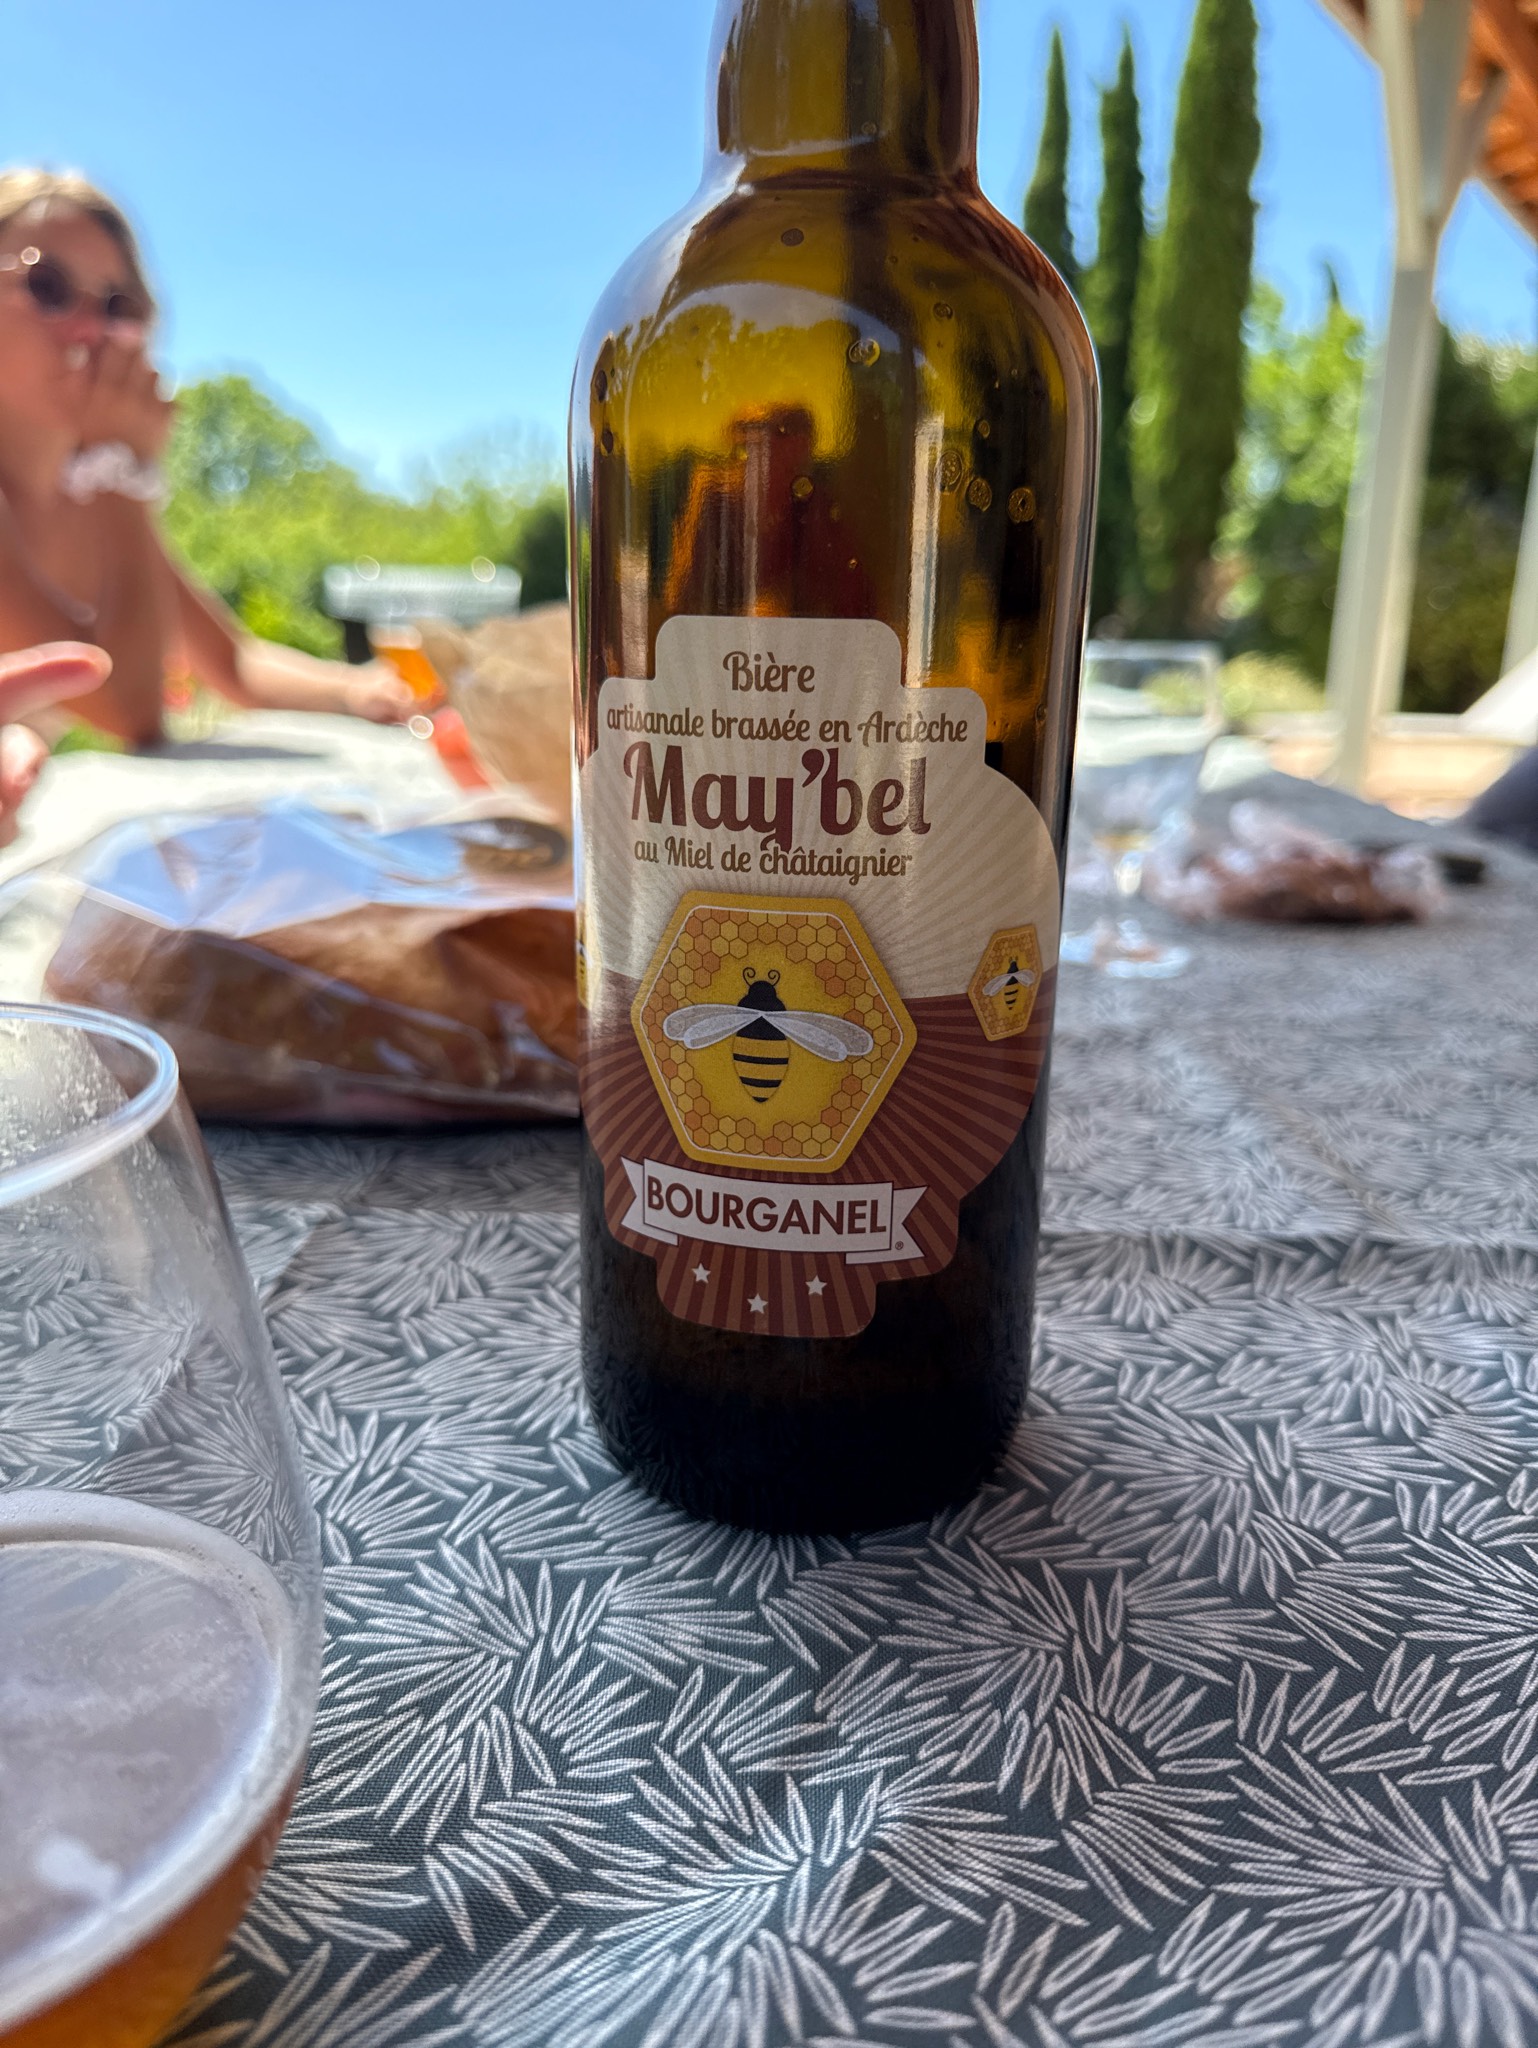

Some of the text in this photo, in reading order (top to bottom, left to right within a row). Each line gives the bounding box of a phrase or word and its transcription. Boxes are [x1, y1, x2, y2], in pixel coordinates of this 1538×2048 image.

[723, 650, 815, 693] Bière
[607, 706, 968, 747] artisanale brassée en Ardèche
[623, 742, 931, 852] May'bel
[634, 836, 913, 885] au Miel de châtaignier
[647, 1175, 887, 1235] BOURGANEL
